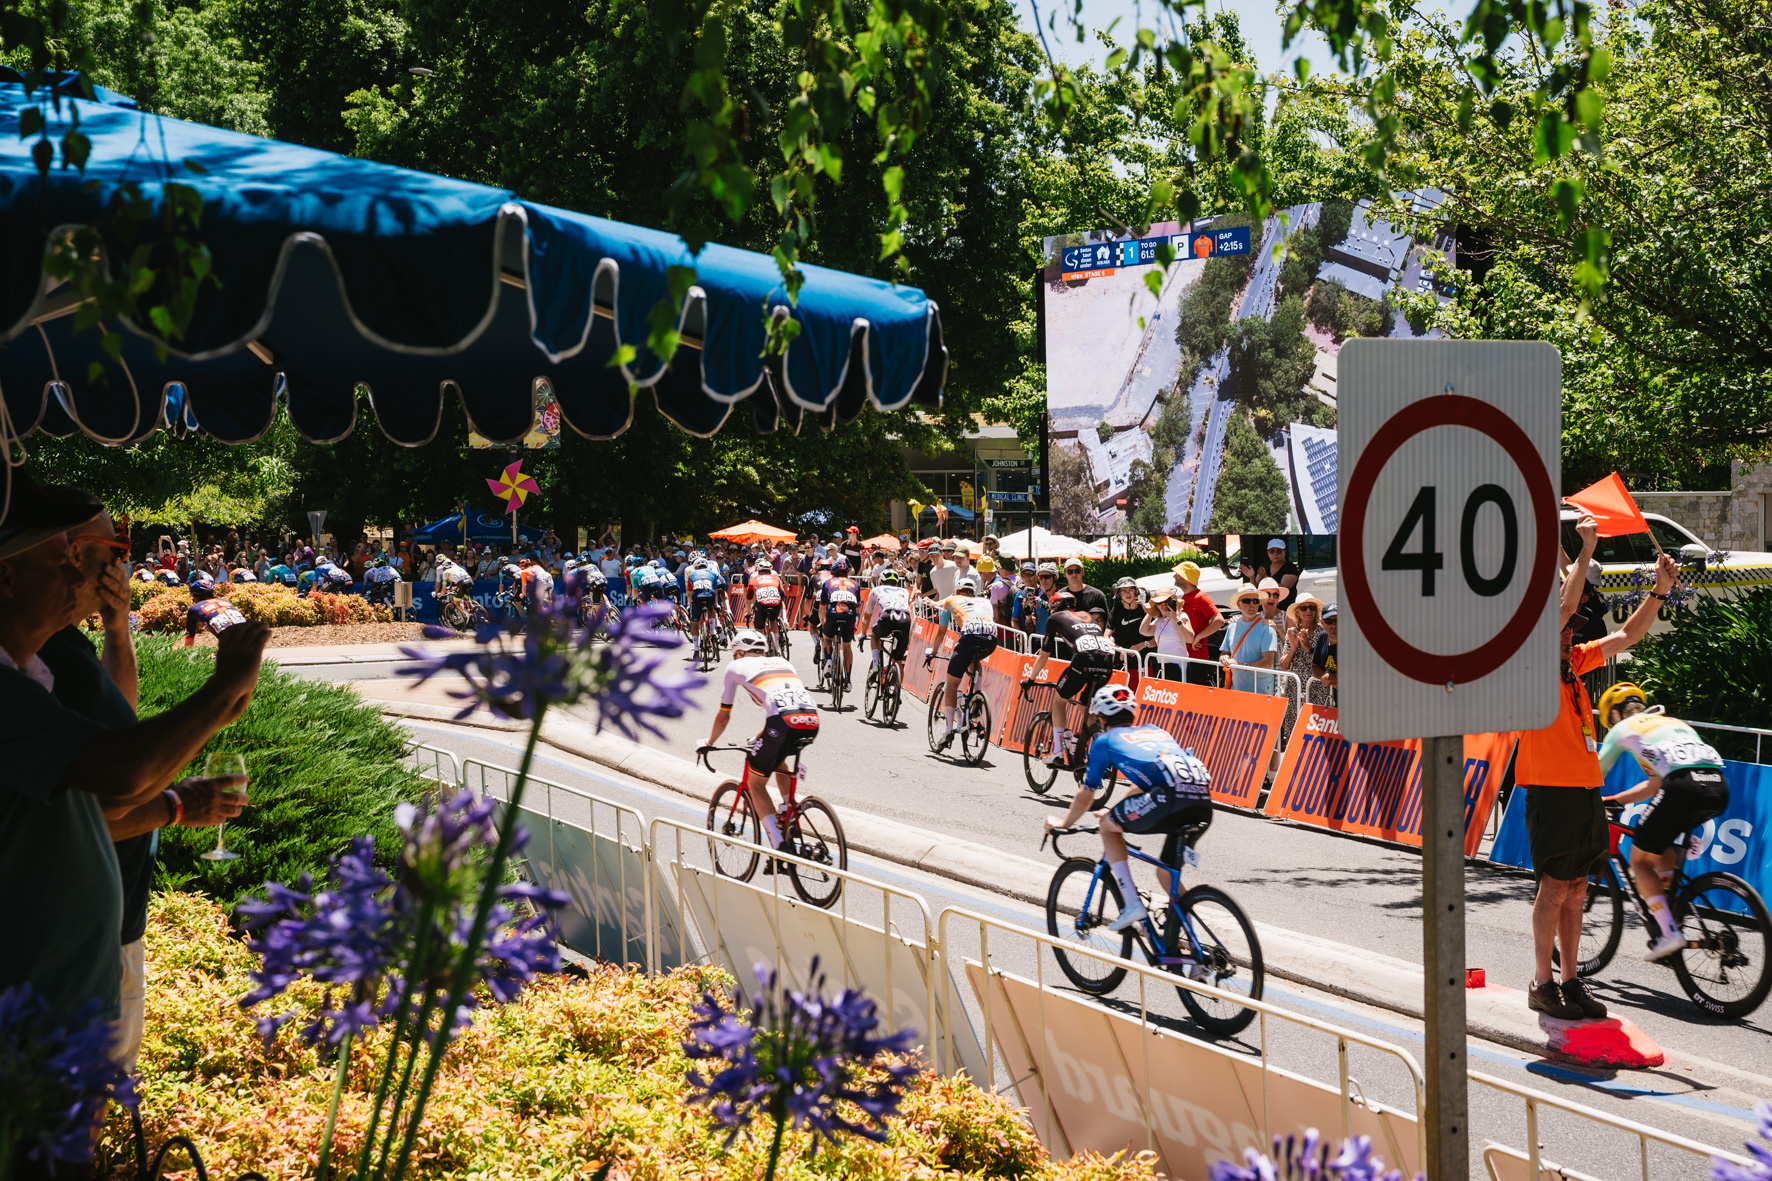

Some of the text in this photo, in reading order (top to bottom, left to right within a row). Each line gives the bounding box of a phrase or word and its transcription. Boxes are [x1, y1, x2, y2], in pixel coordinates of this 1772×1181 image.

[1218, 232, 1233, 240] GAP
[1128, 246, 1134, 259] 1
[1140, 250, 1155, 259] 61.9
[1177, 242, 1184, 252] P
[991, 493, 1026, 501] MEDICAL CLINIC
[1381, 483, 1518, 597] 40
[1080, 638, 1098, 650] 183
[1022, 662, 1049, 681] Saos
[1142, 685, 1178, 706] Santos
[1306, 713, 1342, 735] Sant
[1208, 717, 1269, 799] UNDER
[1281, 733, 1352, 819] TOUR
[1333, 743, 1417, 831] DOWN
[1584, 958, 1601, 973] SWISS
[1692, 991, 1725, 1014] DT SWISS
